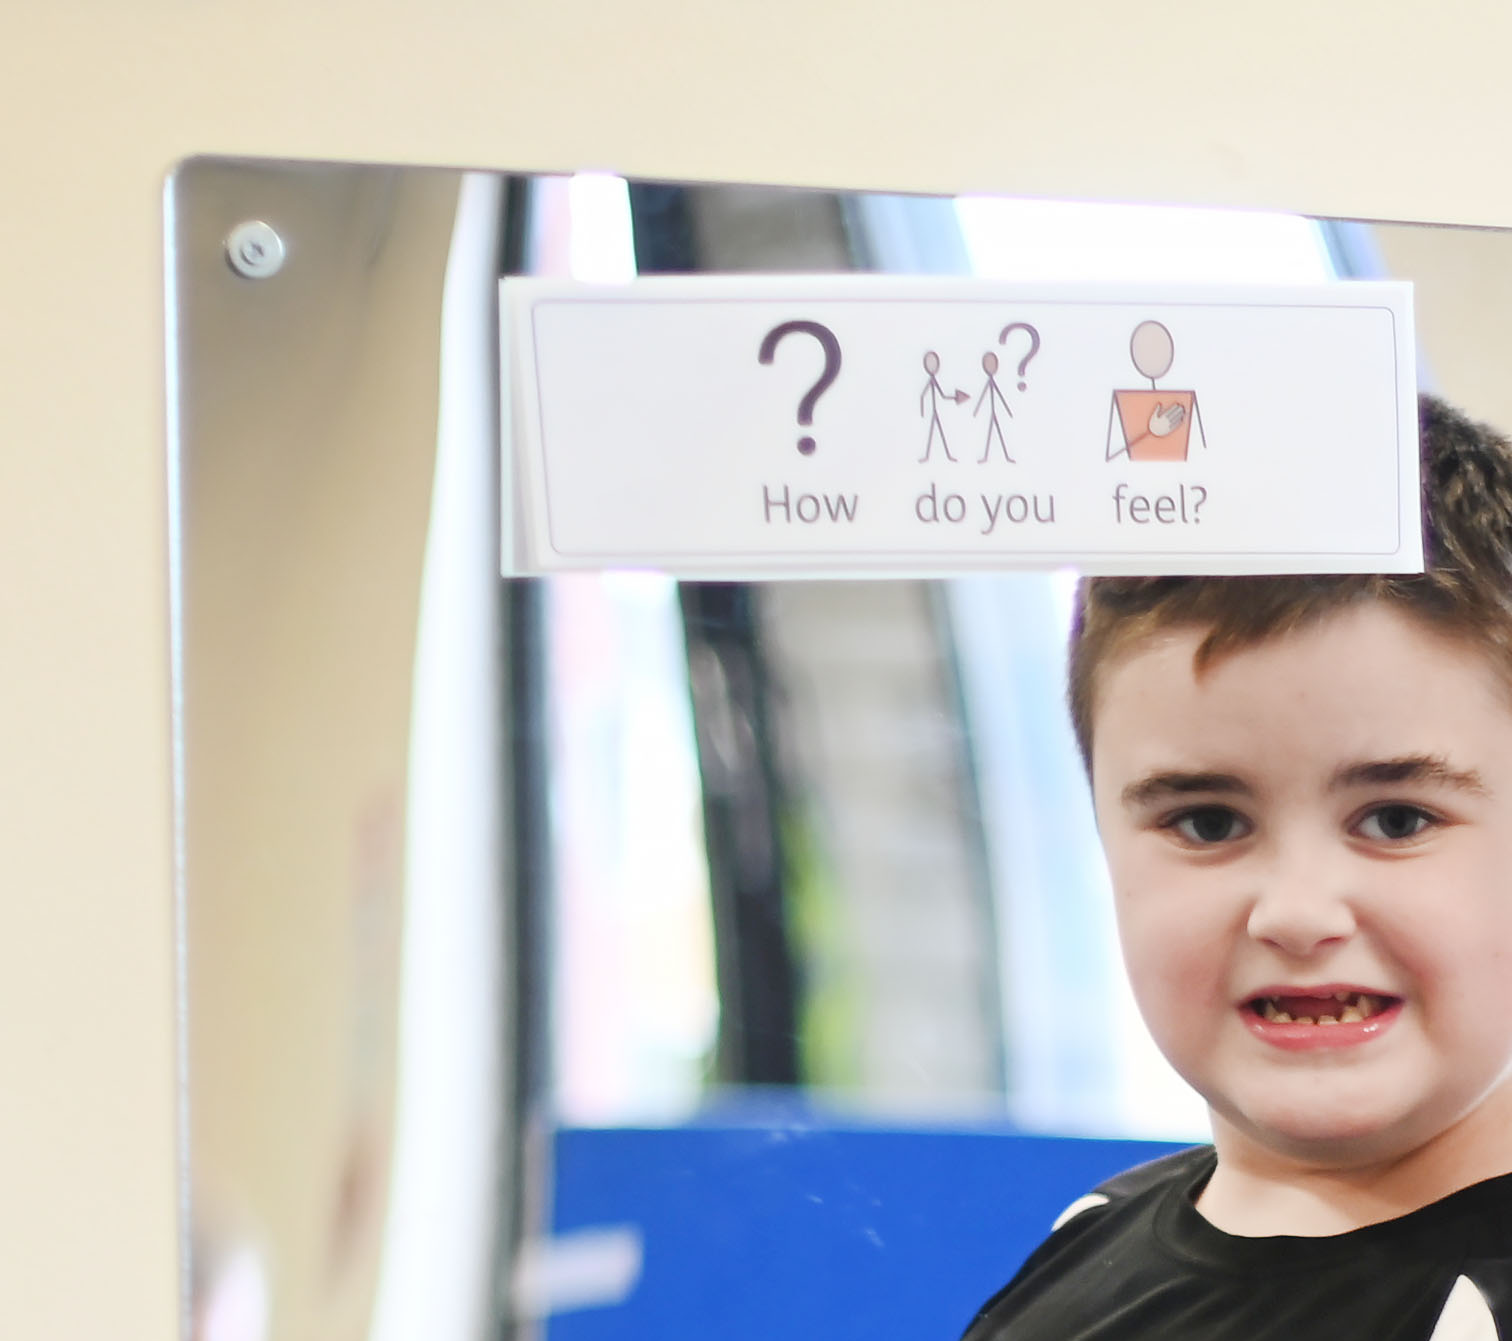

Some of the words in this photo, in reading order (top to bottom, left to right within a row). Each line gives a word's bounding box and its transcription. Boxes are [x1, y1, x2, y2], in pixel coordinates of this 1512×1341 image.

[763, 485, 859, 523] How
[915, 483, 966, 523] do
[981, 492, 1056, 535] you
[1113, 484, 1207, 525] feel?
